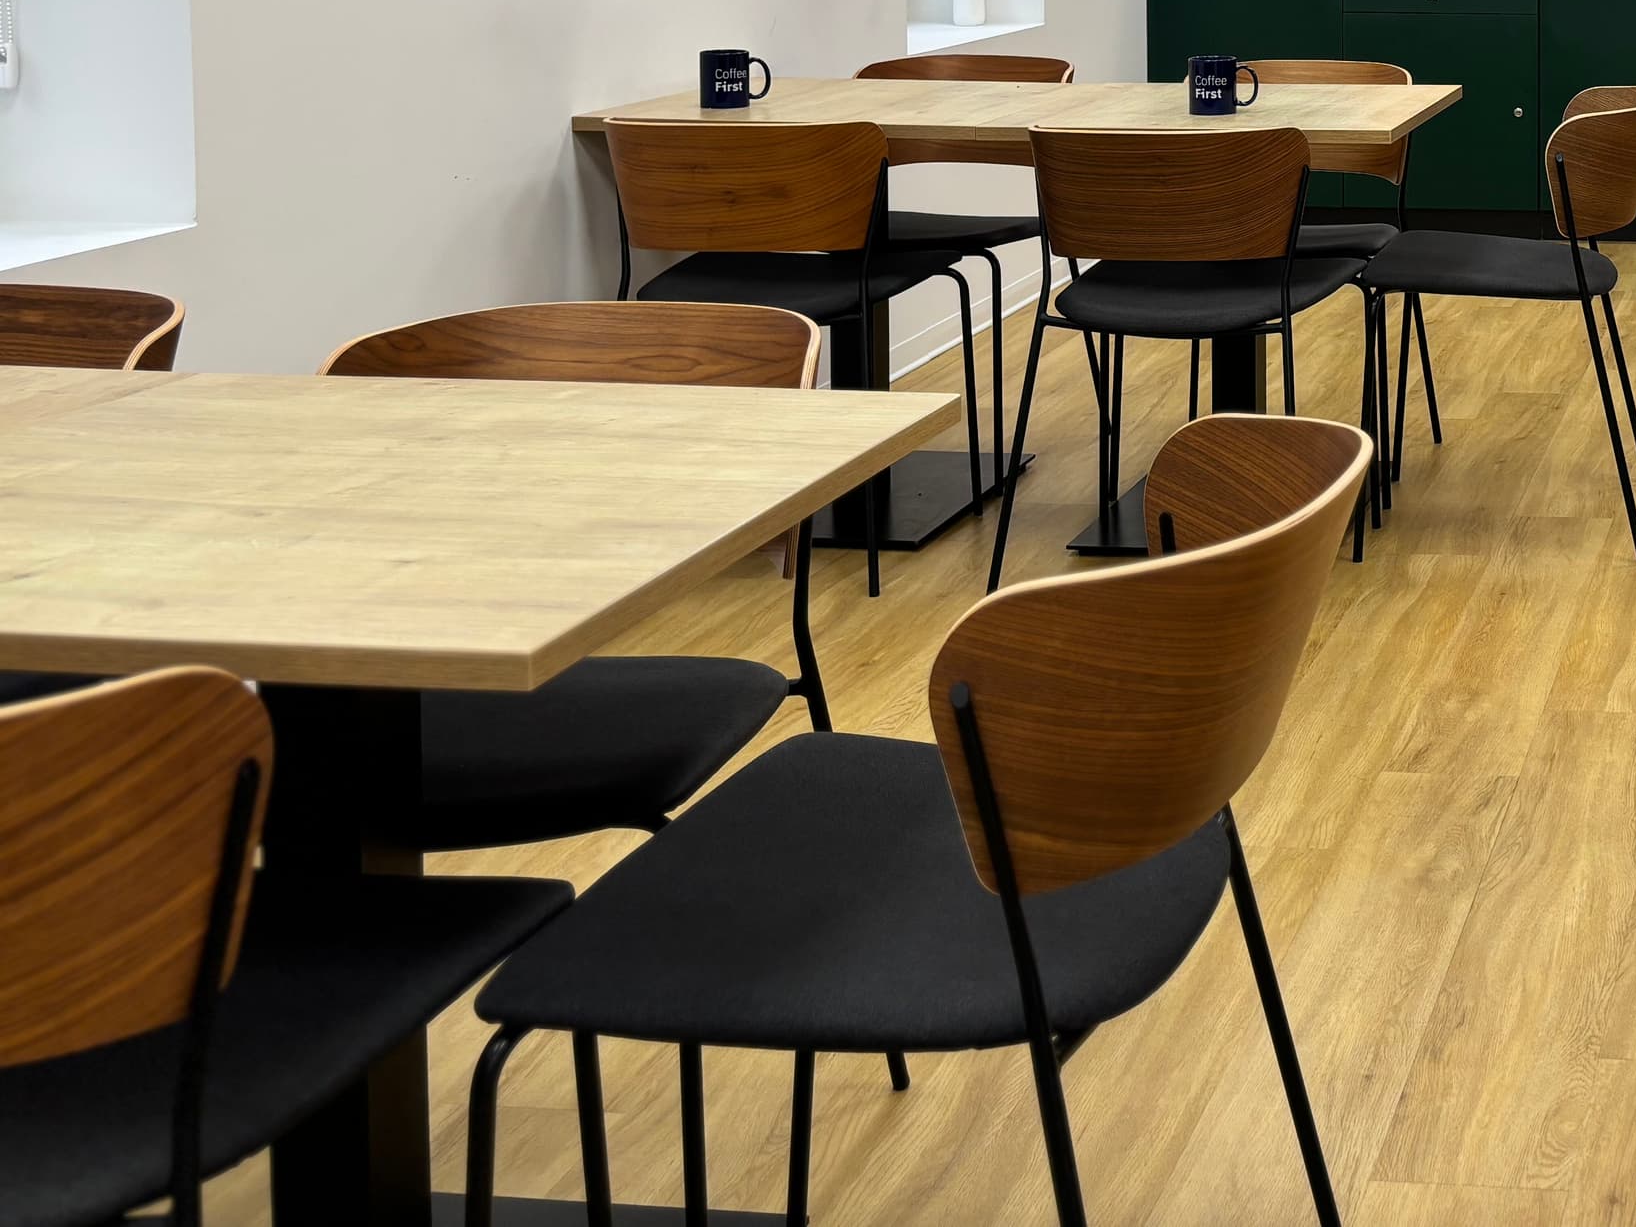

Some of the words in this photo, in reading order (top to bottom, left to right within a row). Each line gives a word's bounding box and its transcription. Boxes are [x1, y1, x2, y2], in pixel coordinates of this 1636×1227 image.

[715, 68, 747, 80] Coffee
[1195, 75, 1227, 86] Coffee
[715, 81, 743, 93] First
[1195, 88, 1222, 99] First
